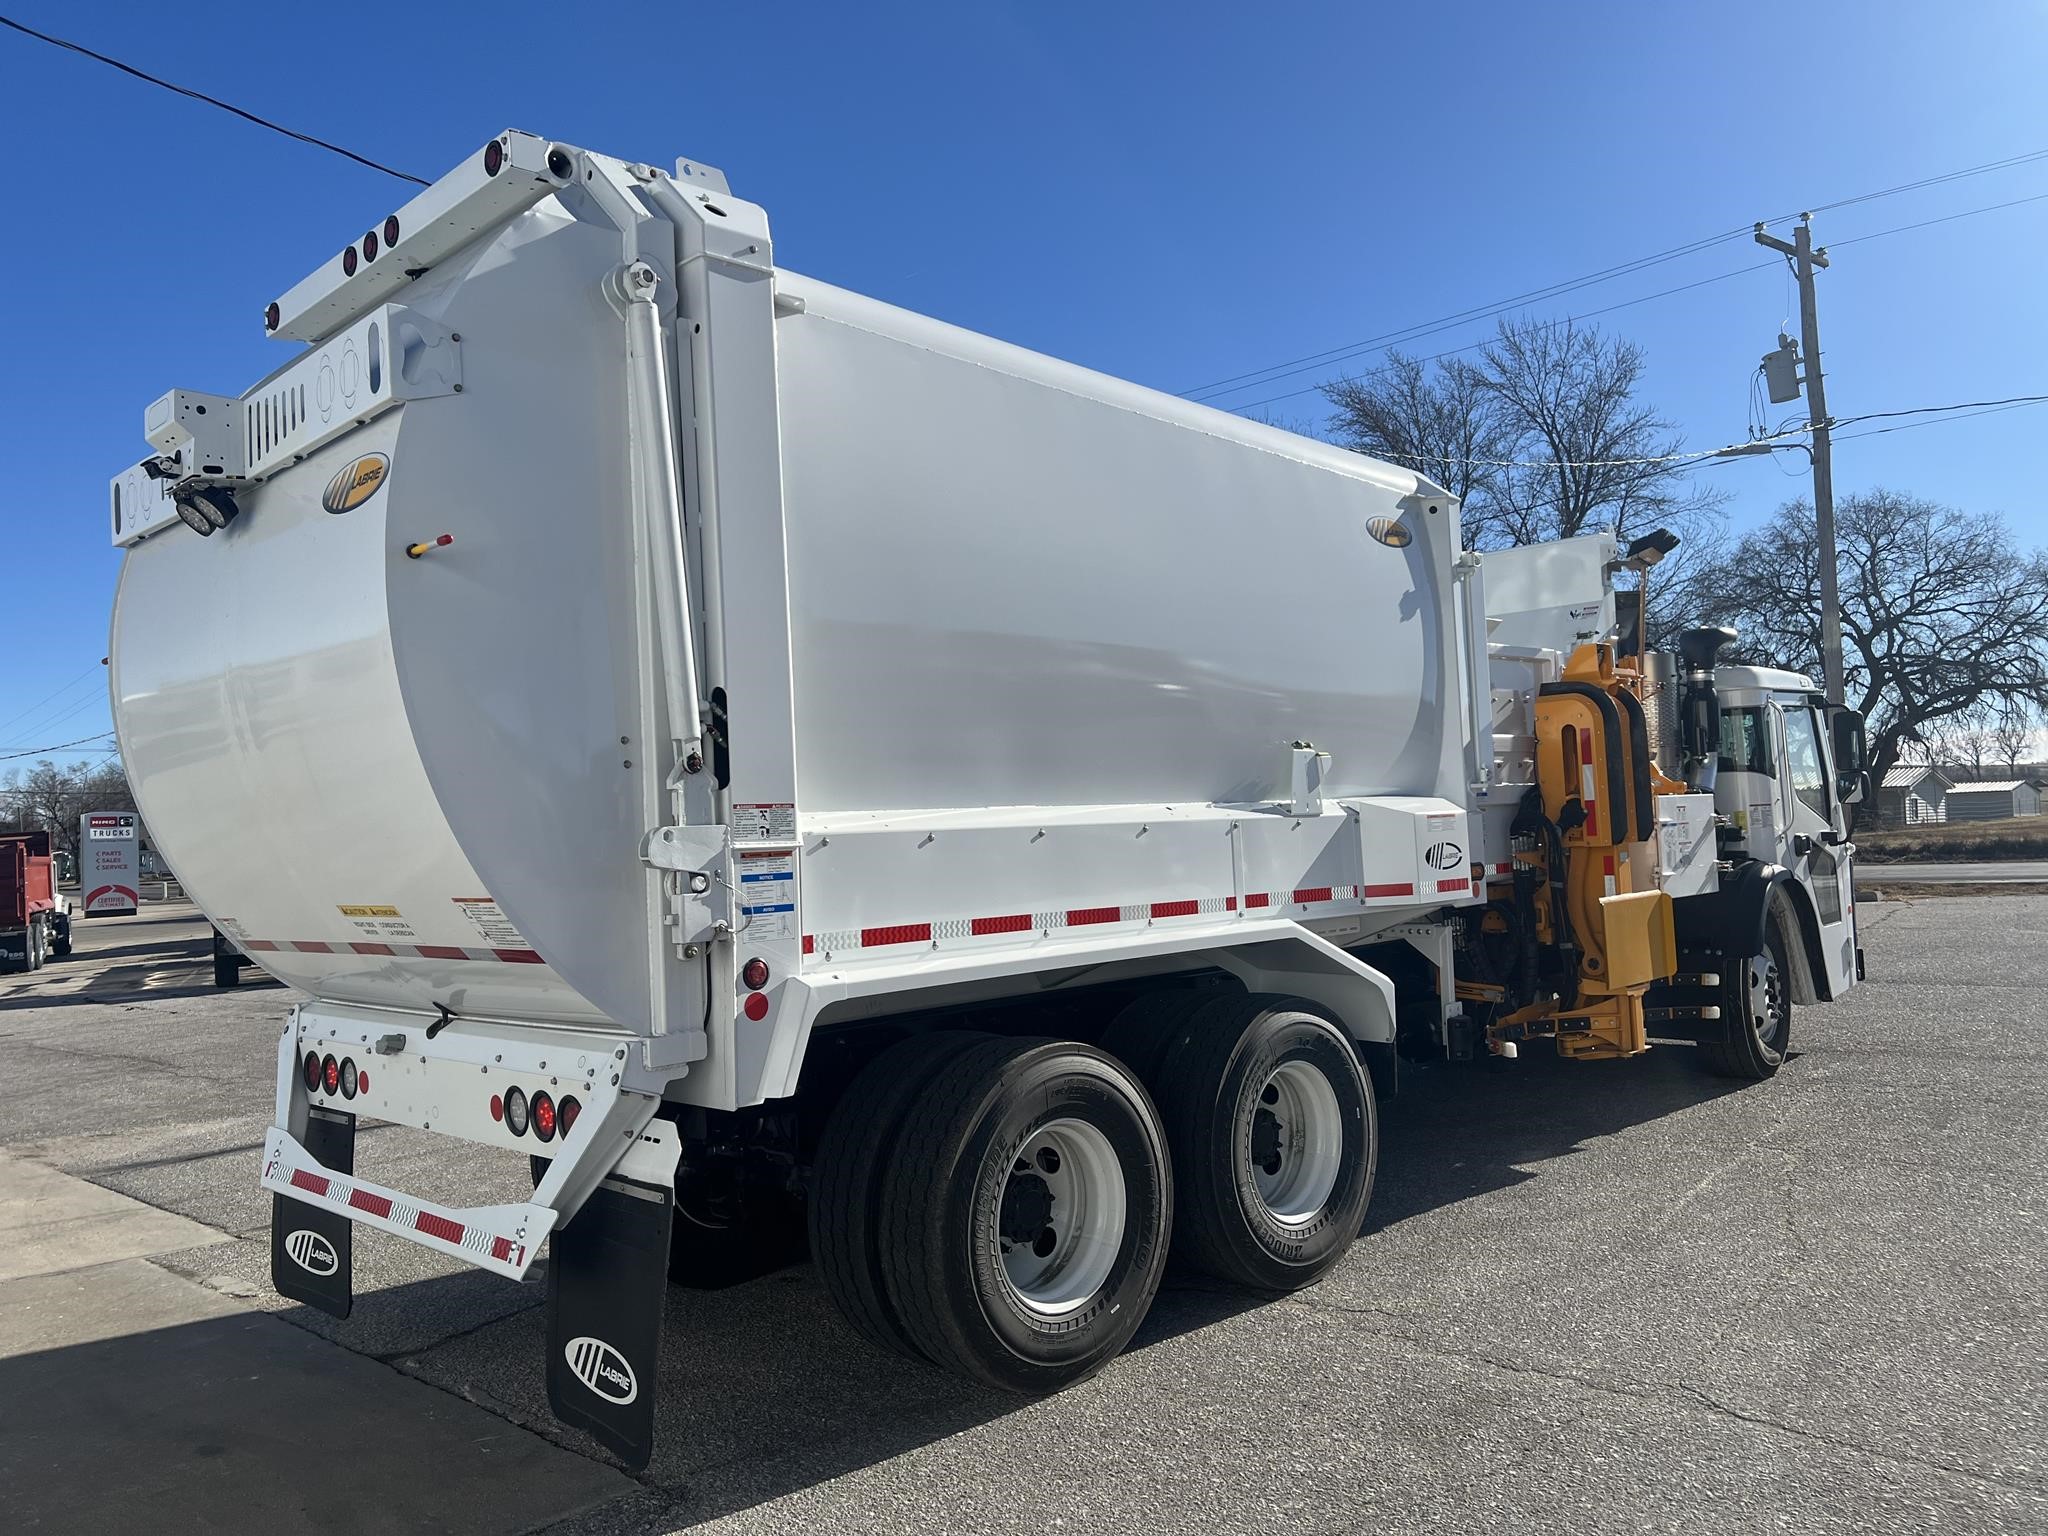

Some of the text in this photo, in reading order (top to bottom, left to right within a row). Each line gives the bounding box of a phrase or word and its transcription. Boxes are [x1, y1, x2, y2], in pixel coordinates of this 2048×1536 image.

[351, 465, 383, 490] LABRIE
[93, 829, 131, 837] TRUCKS
[973, 1135, 1008, 1300] BRIDGESTONE
[311, 1247, 334, 1265] LABRIE
[600, 1363, 631, 1391] LABRIE
